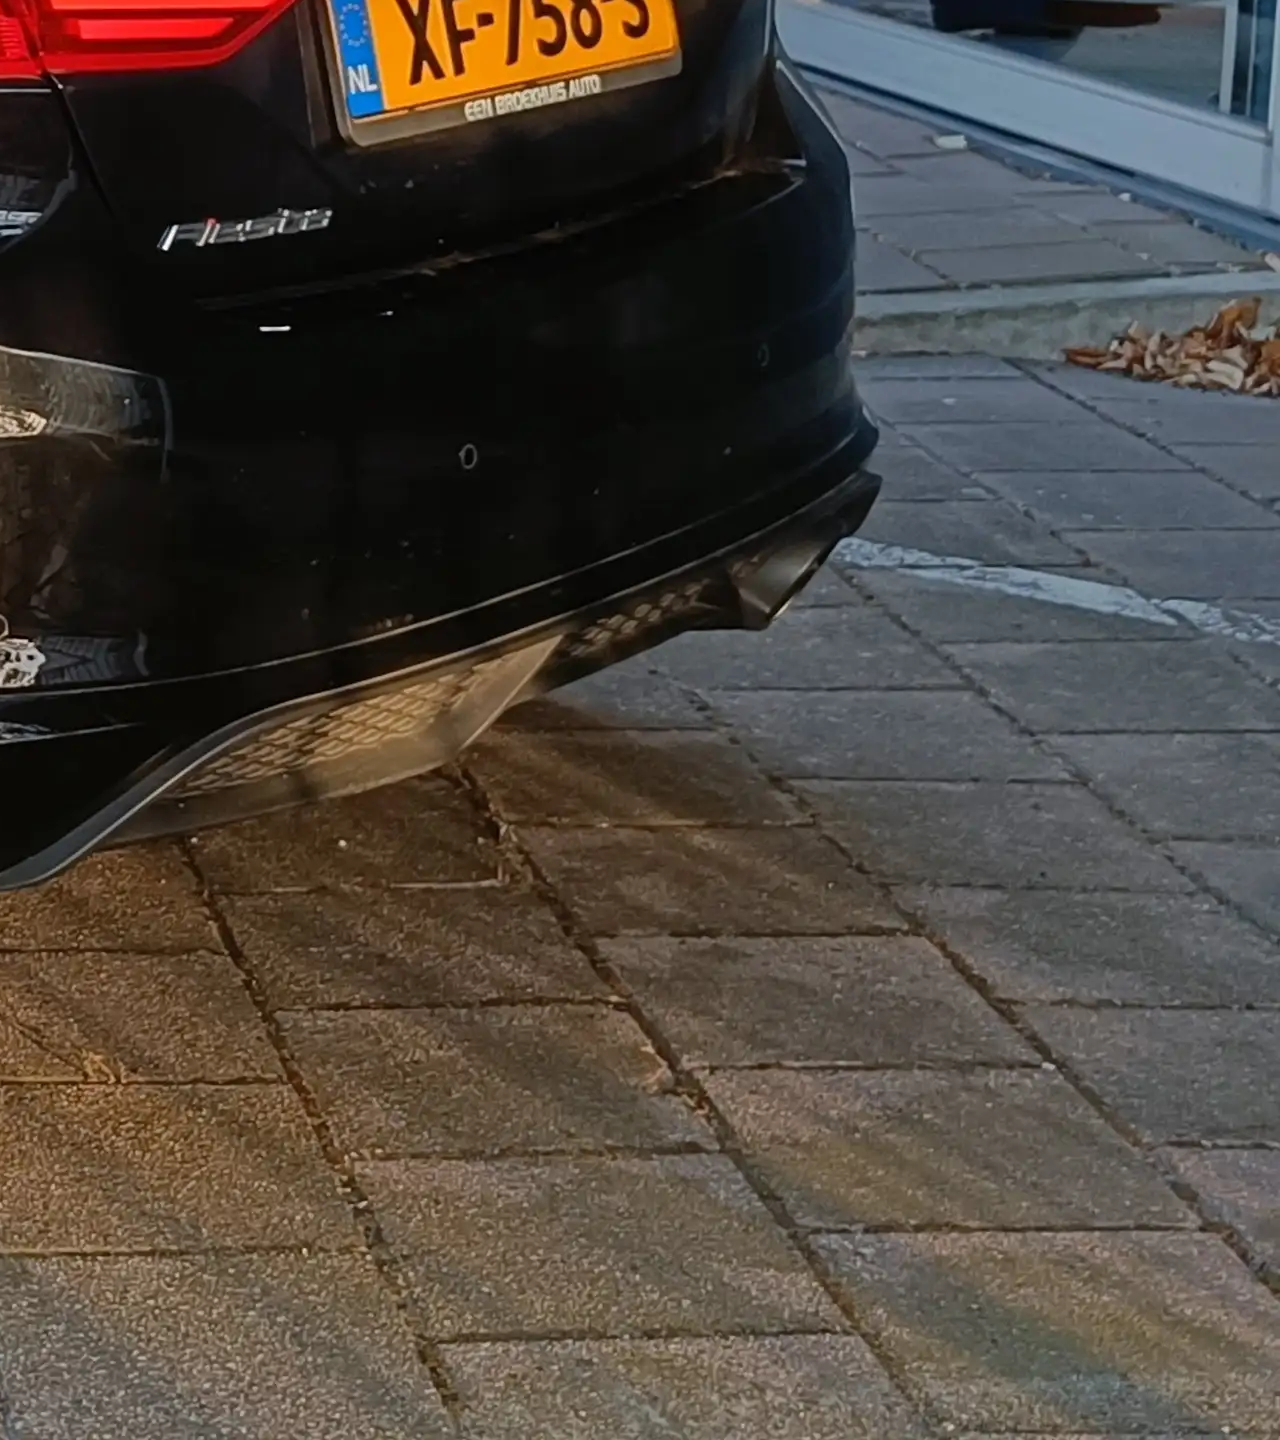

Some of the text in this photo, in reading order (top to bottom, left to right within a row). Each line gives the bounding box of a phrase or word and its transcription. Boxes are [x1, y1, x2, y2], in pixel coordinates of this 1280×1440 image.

[347, 62, 377, 95] NL
[464, 74, 601, 122] EEN BROEKHUIS AUTO
[156, 207, 333, 251] Fiesta
